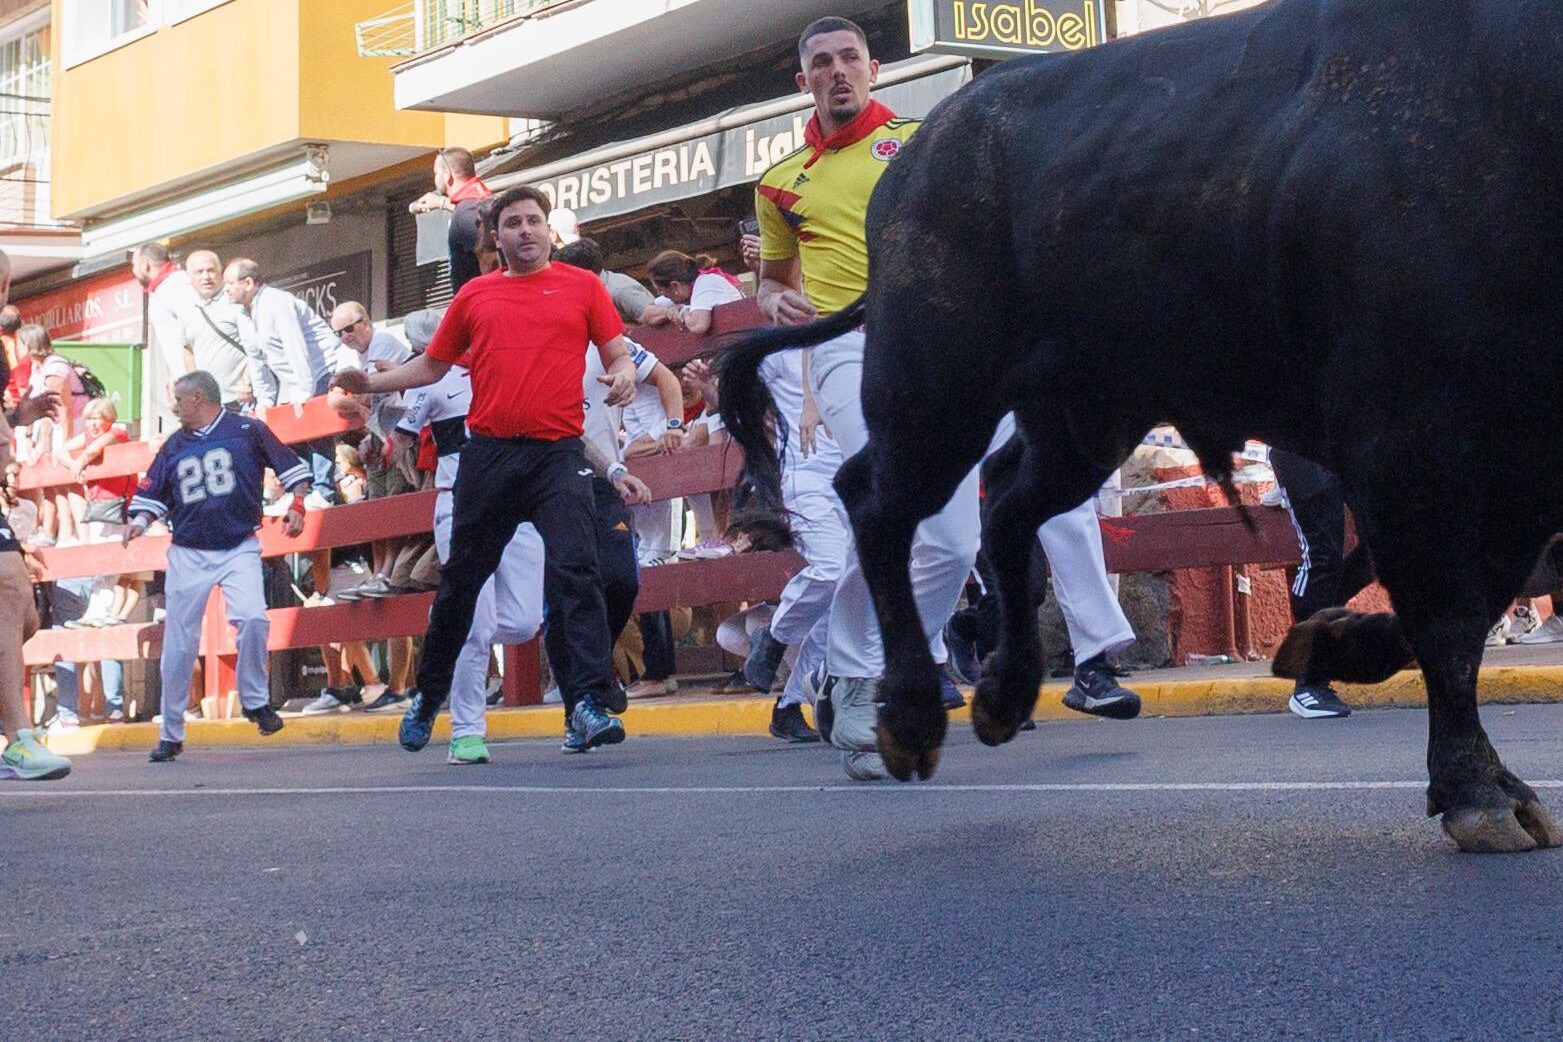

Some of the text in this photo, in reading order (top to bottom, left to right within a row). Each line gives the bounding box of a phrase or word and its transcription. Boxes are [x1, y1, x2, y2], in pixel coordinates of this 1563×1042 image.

[538, 114, 806, 210] ORISTERIA isab
[177, 447, 237, 504] 28
